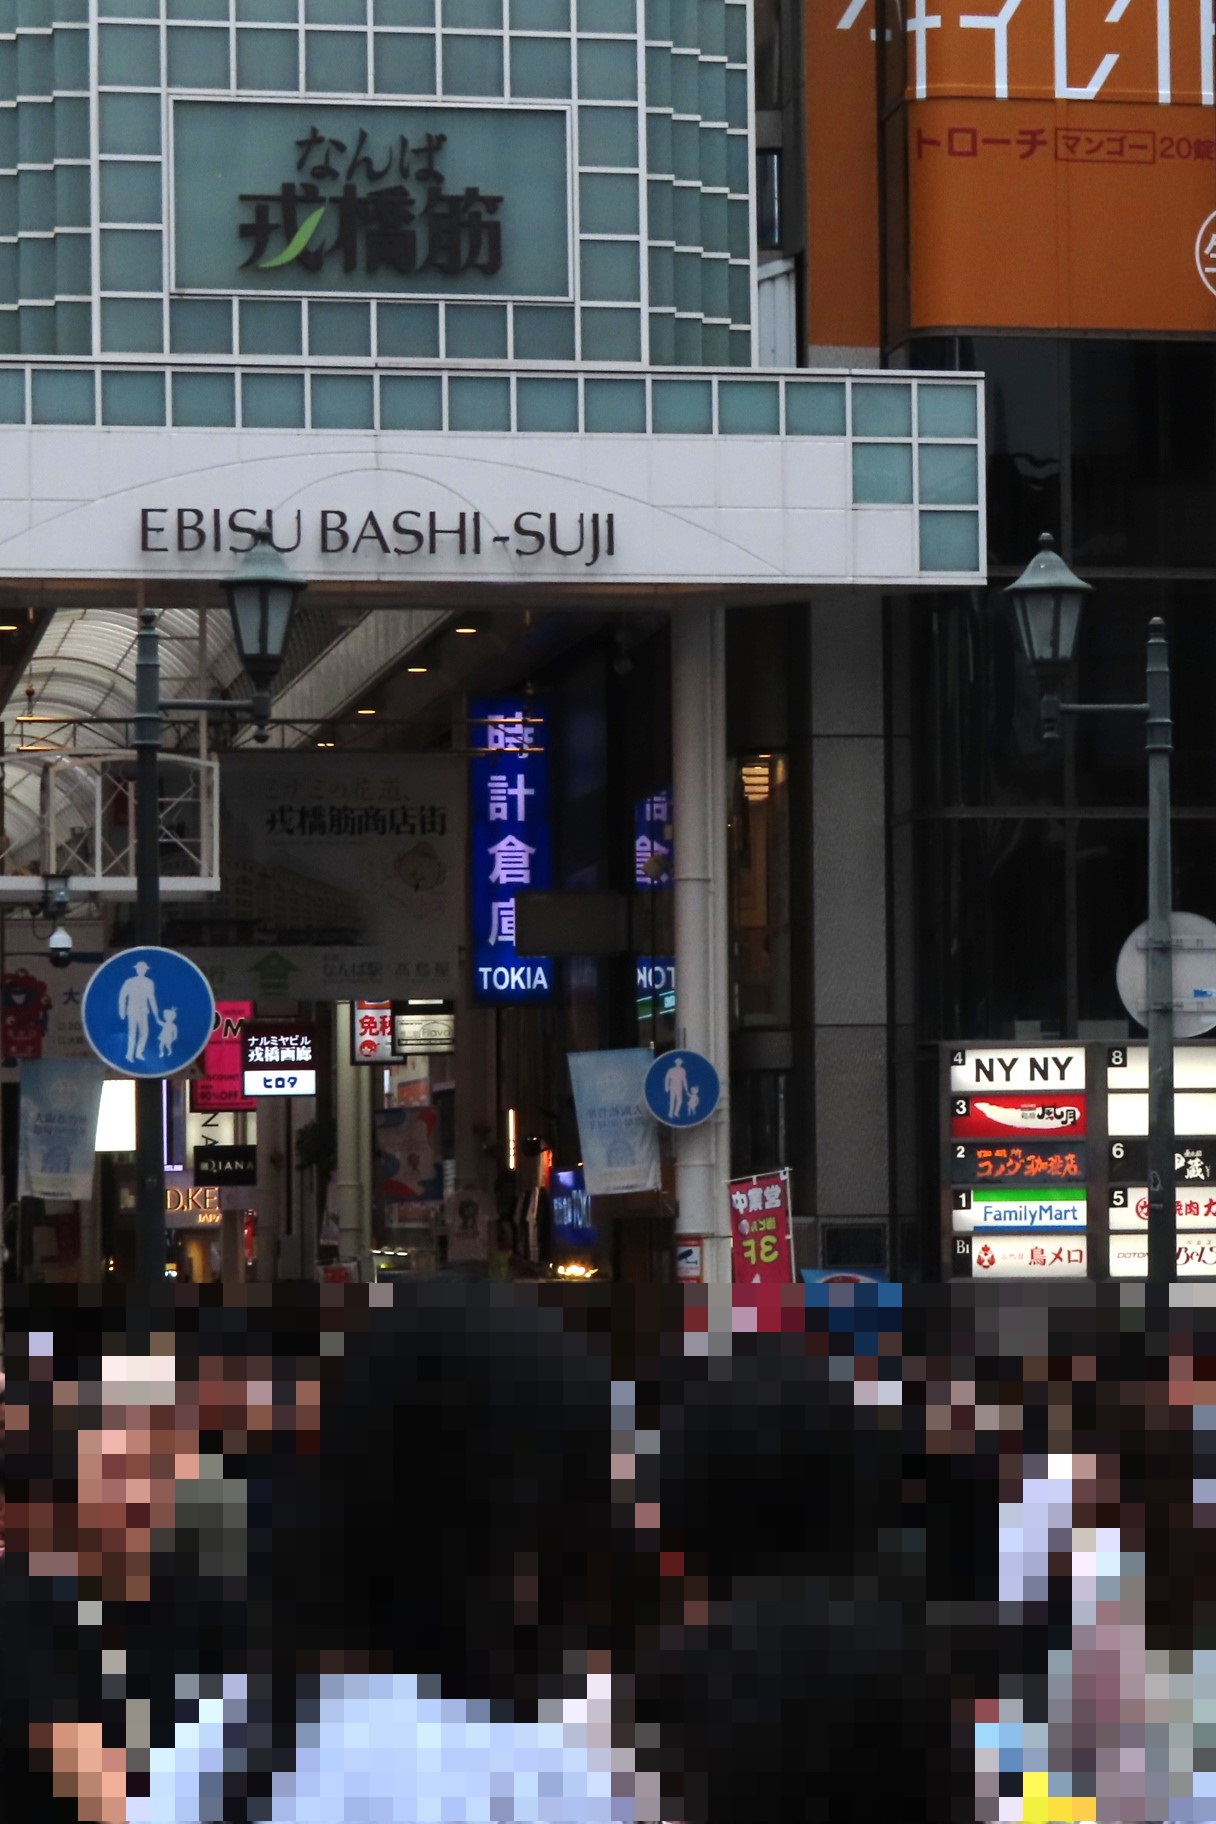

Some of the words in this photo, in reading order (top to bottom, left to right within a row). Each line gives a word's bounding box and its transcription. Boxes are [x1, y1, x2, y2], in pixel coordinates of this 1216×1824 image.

[917, 127, 1047, 160] トローチ
[1061, 133, 1149, 158] マンゴー
[296, 125, 447, 183] なんば
[239, 182, 503, 275] 戎橋筋
[140, 508, 302, 554] EBISU
[478, 966, 548, 990] TOKIA
[248, 1035, 311, 1047] ナルミヤビル
[953, 1051, 963, 1064] 4
[975, 1058, 1018, 1082] NY
[1030, 1056, 1074, 1081] NY
[1112, 1051, 1123, 1064] 8
[263, 1077, 298, 1088] ヒロタ
[956, 1101, 967, 1114] 3
[957, 1146, 965, 1158] 2
[1112, 1144, 1124, 1158] 6
[1113, 1191, 1124, 1205] 5
[959, 1193, 967, 1207] 1
[983, 1206, 1078, 1225] FamilyMart
[1028, 1247, 1083, 1266] 鳥メロ
